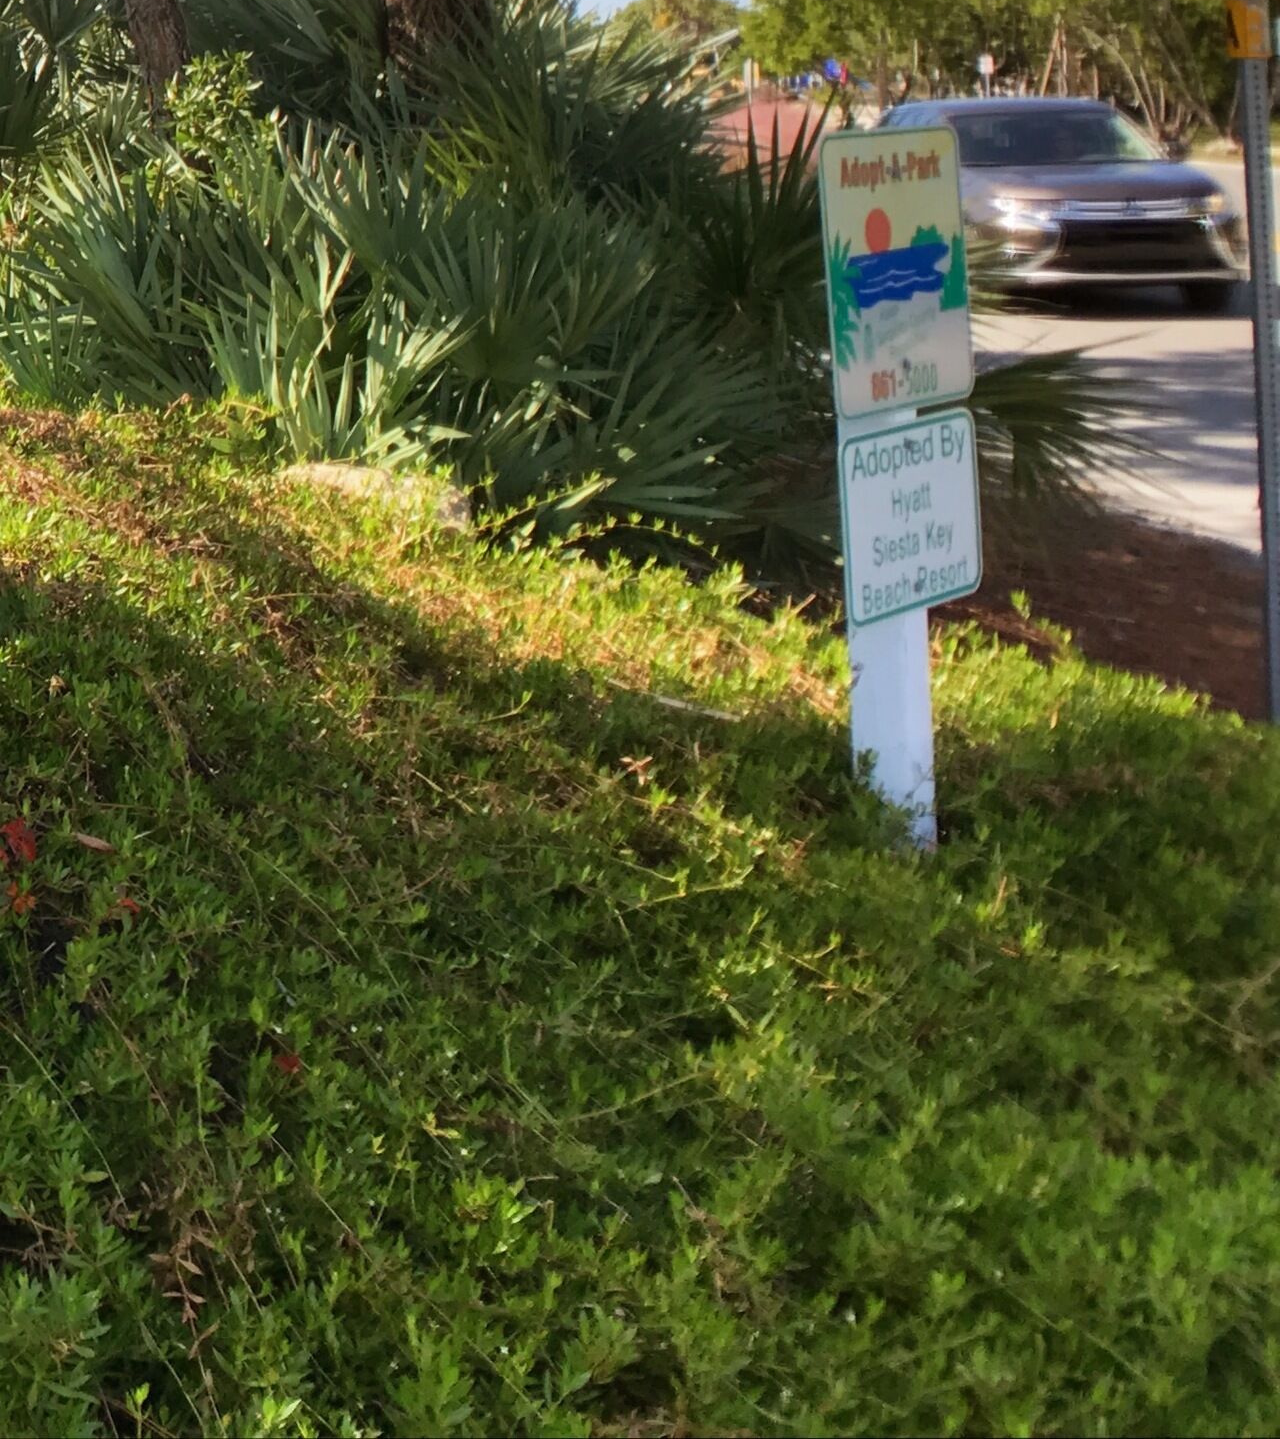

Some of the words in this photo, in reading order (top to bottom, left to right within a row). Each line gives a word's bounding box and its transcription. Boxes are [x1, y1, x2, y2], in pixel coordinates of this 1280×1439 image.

[851, 431, 934, 481] Adopted
[940, 424, 966, 463] By
[891, 483, 931, 522] Hyatt
[873, 531, 921, 566] Siesta
[925, 518, 954, 554] Key
[861, 576, 912, 616] Beach
[916, 558, 968, 594] Resort
